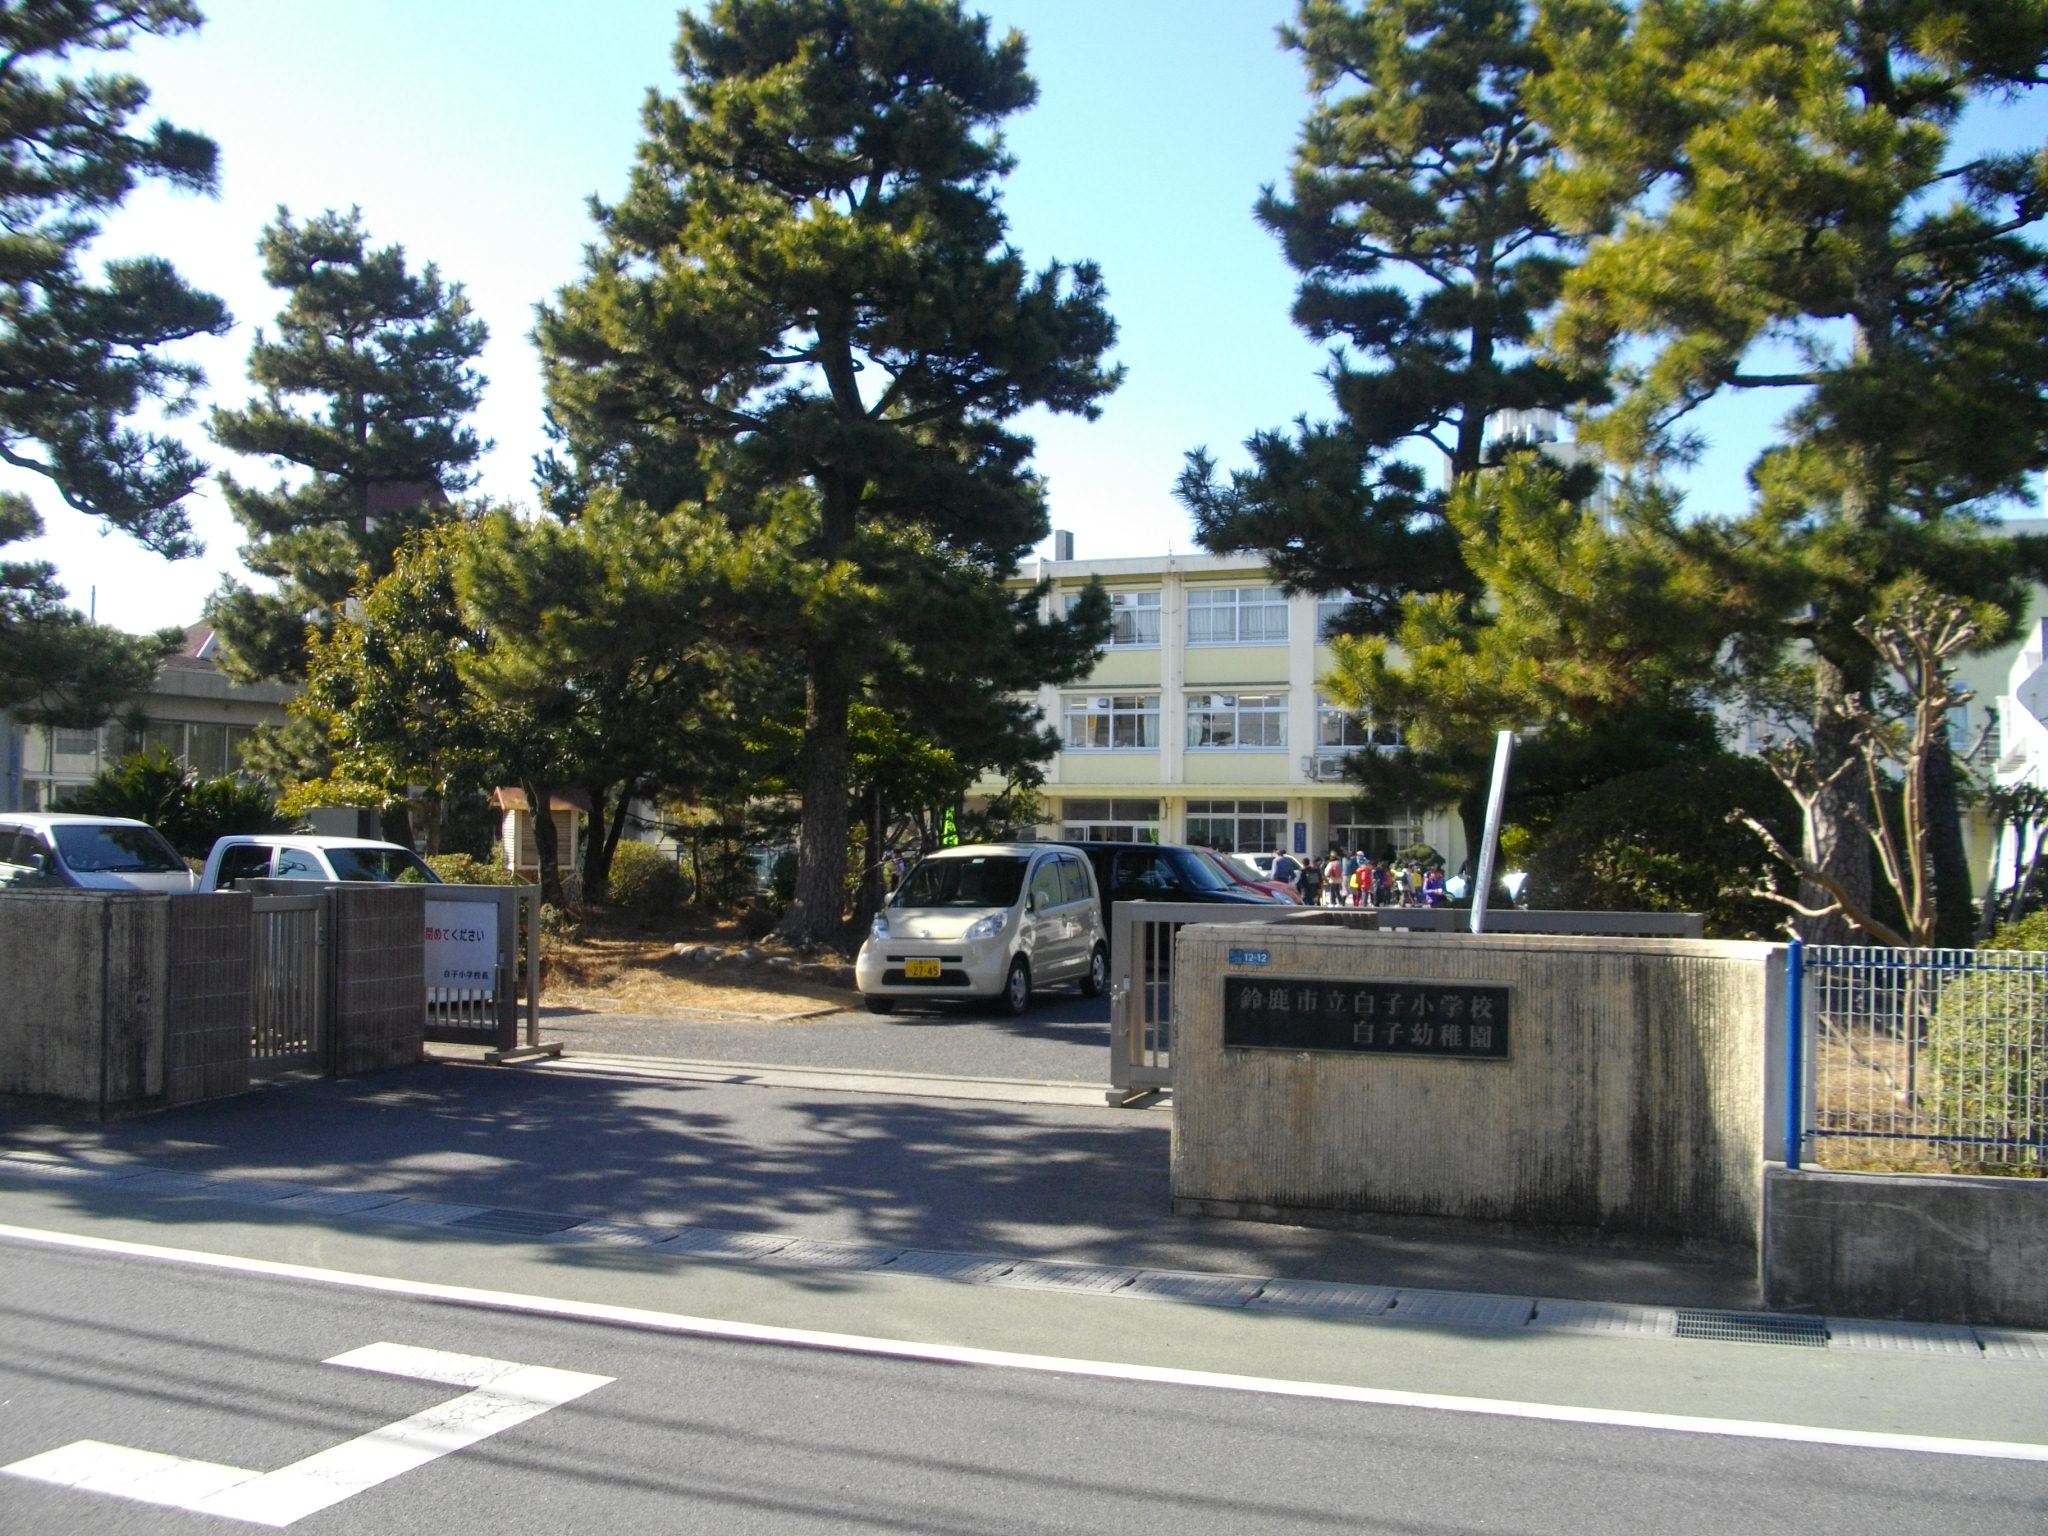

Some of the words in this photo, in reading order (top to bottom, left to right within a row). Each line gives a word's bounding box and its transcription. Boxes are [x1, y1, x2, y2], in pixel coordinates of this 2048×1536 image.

[1244, 952, 1267, 963] 12-12
[1239, 986, 1494, 1019] 鈴鹿市立白子小学校
[1353, 1020, 1493, 1049] 白子幼稚園
